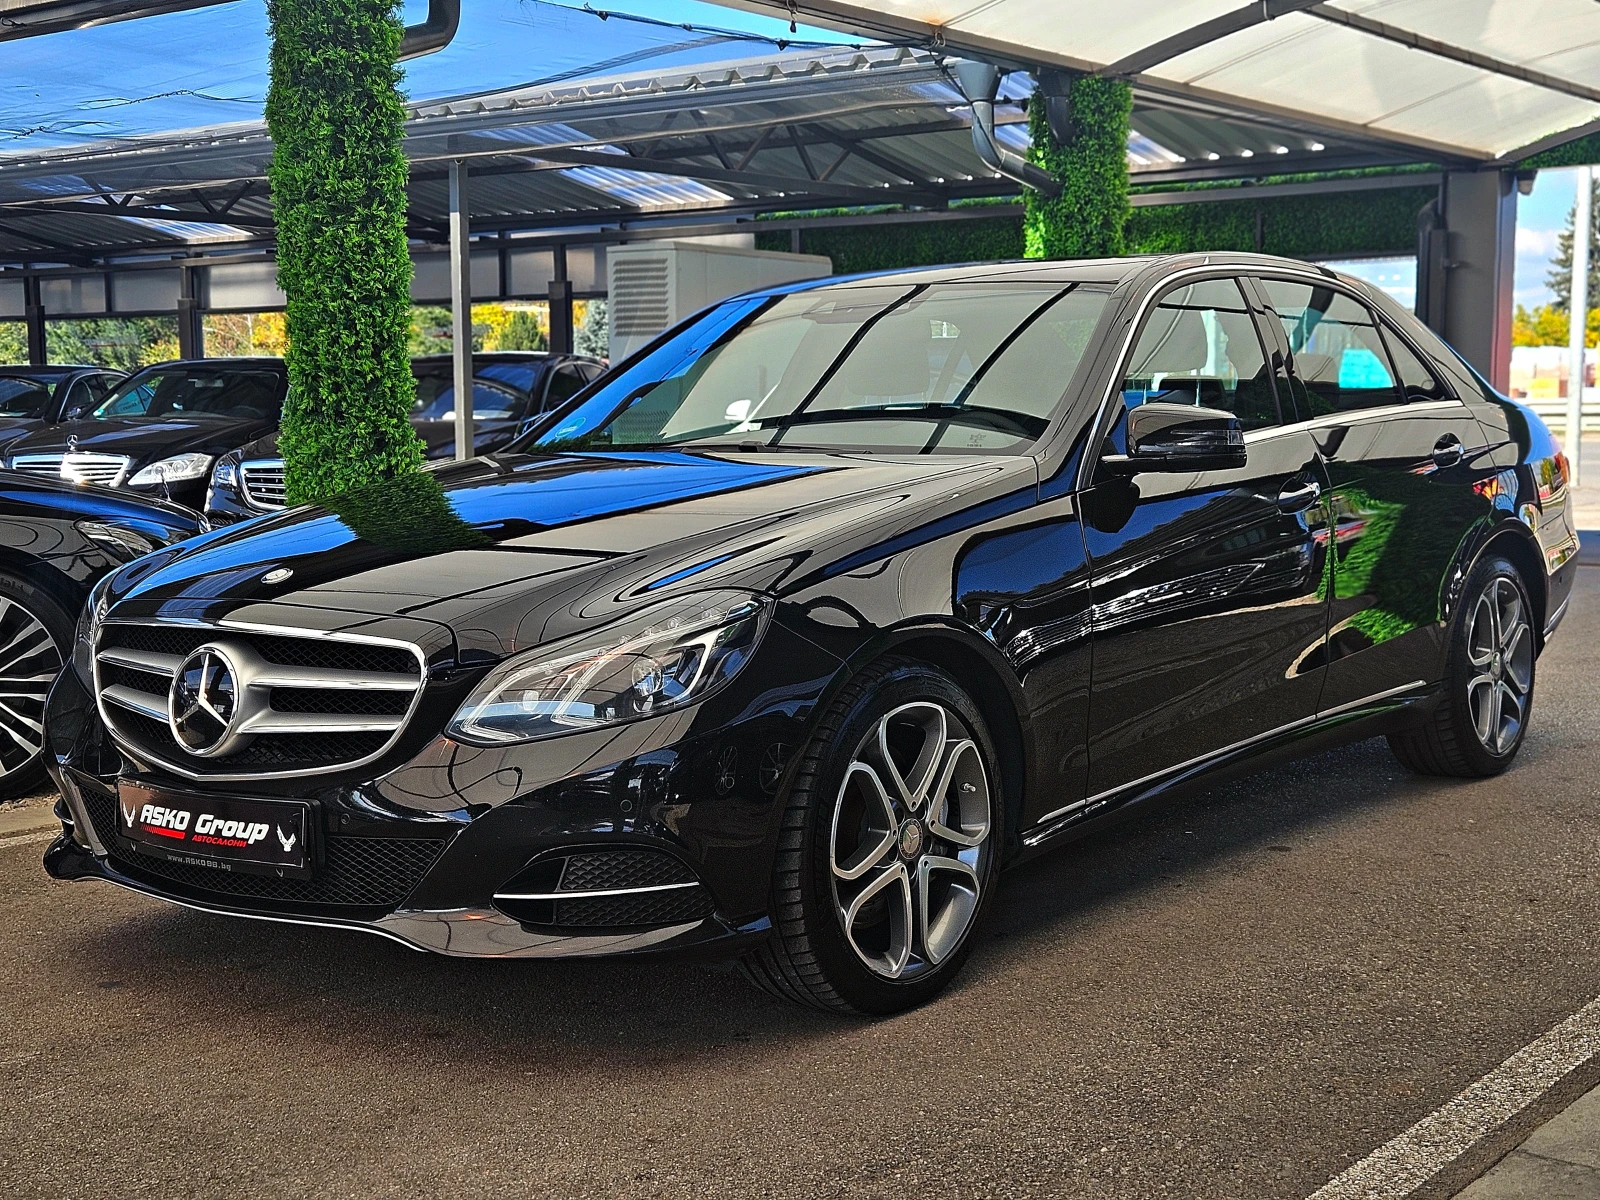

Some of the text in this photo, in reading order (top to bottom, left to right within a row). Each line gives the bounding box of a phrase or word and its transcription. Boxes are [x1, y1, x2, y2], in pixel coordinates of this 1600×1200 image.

[140, 804, 269, 844] ASKO Group
[192, 834, 247, 848] АВТОСАЛОНИ
